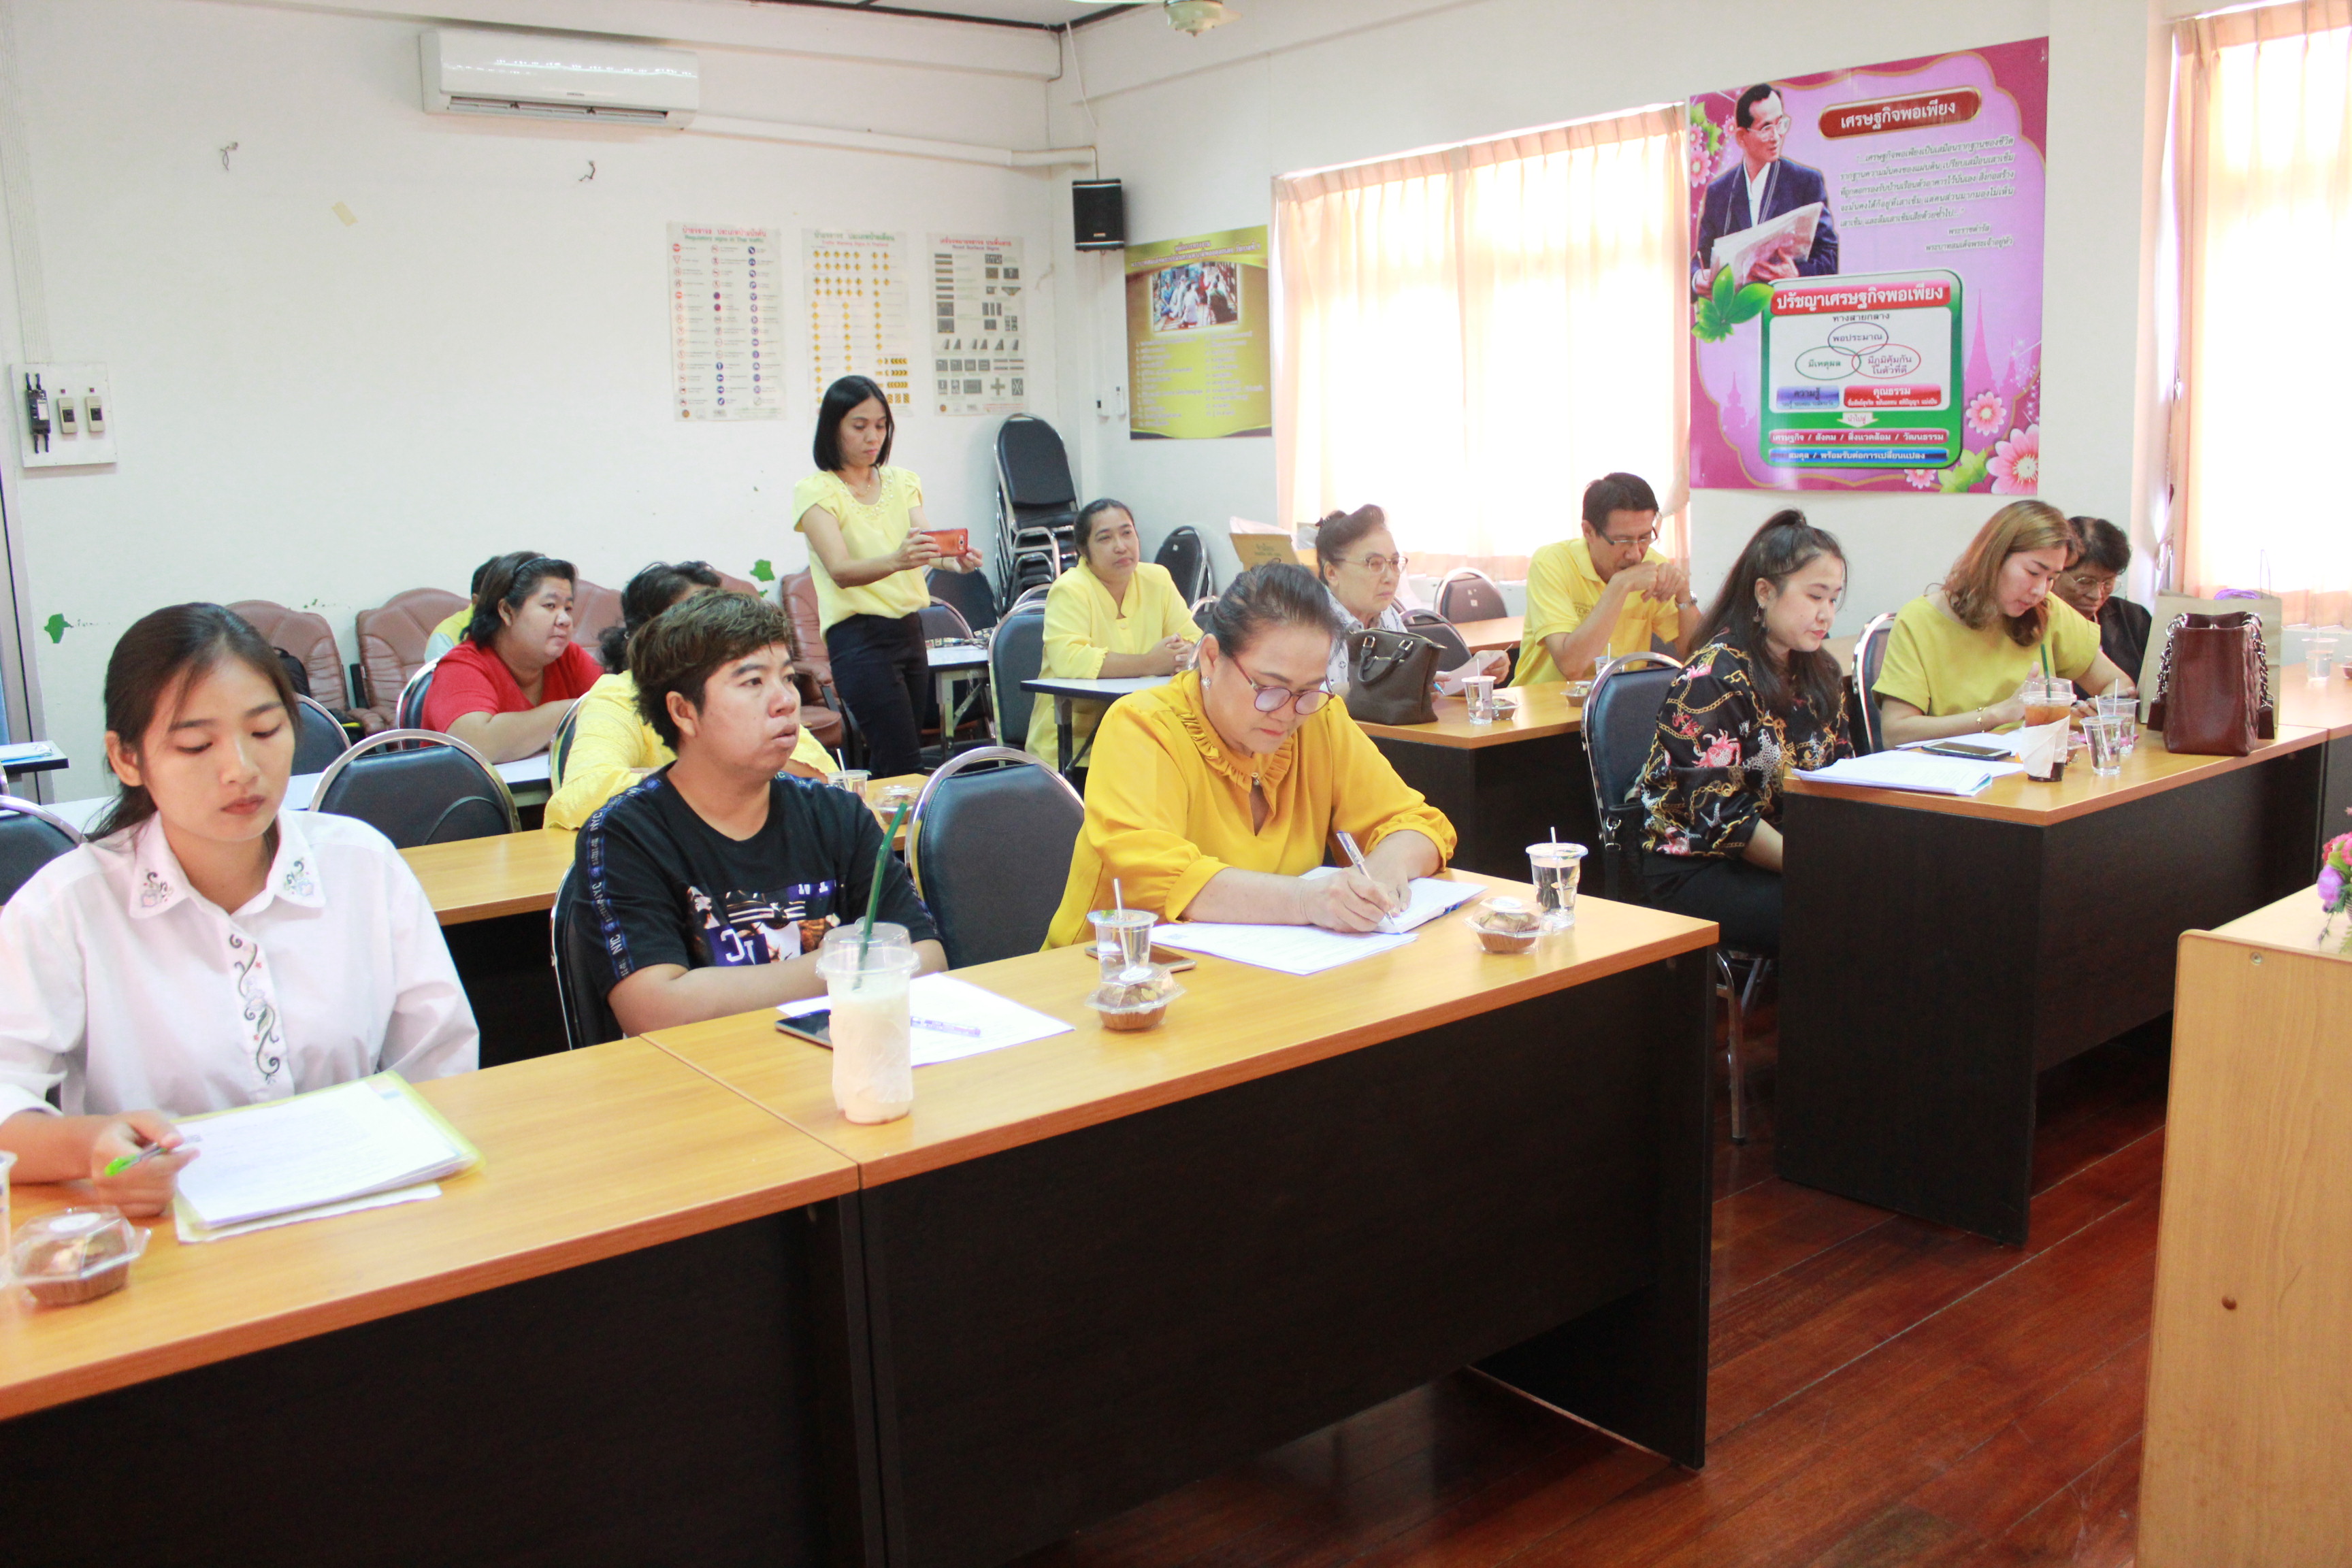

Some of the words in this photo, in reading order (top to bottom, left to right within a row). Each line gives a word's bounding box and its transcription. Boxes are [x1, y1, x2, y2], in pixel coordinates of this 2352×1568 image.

[1840, 99, 1956, 130] เศรษฐกิจพอเพียง
[1776, 282, 1944, 312] ปรัชญาเศรษฐกิจพอเพียง
[1833, 312, 1890, 323] ทางสายกลาง
[1833, 333, 1882, 343] พอประมาณ
[1808, 359, 1842, 371] มีเหตุผล
[1872, 364, 1908, 375] ในตัวที่ดี
[1873, 387, 1911, 399] คุณธรรม
[1772, 432, 1805, 444] เศรษฐกิจ
[1815, 431, 1837, 442] สังคม
[1848, 431, 1891, 442] สิ่งแวดล้อม
[1903, 431, 1944, 441] วัฒนธรรม
[589, 811, 603, 832] NYC
[609, 934, 623, 956] NYC
